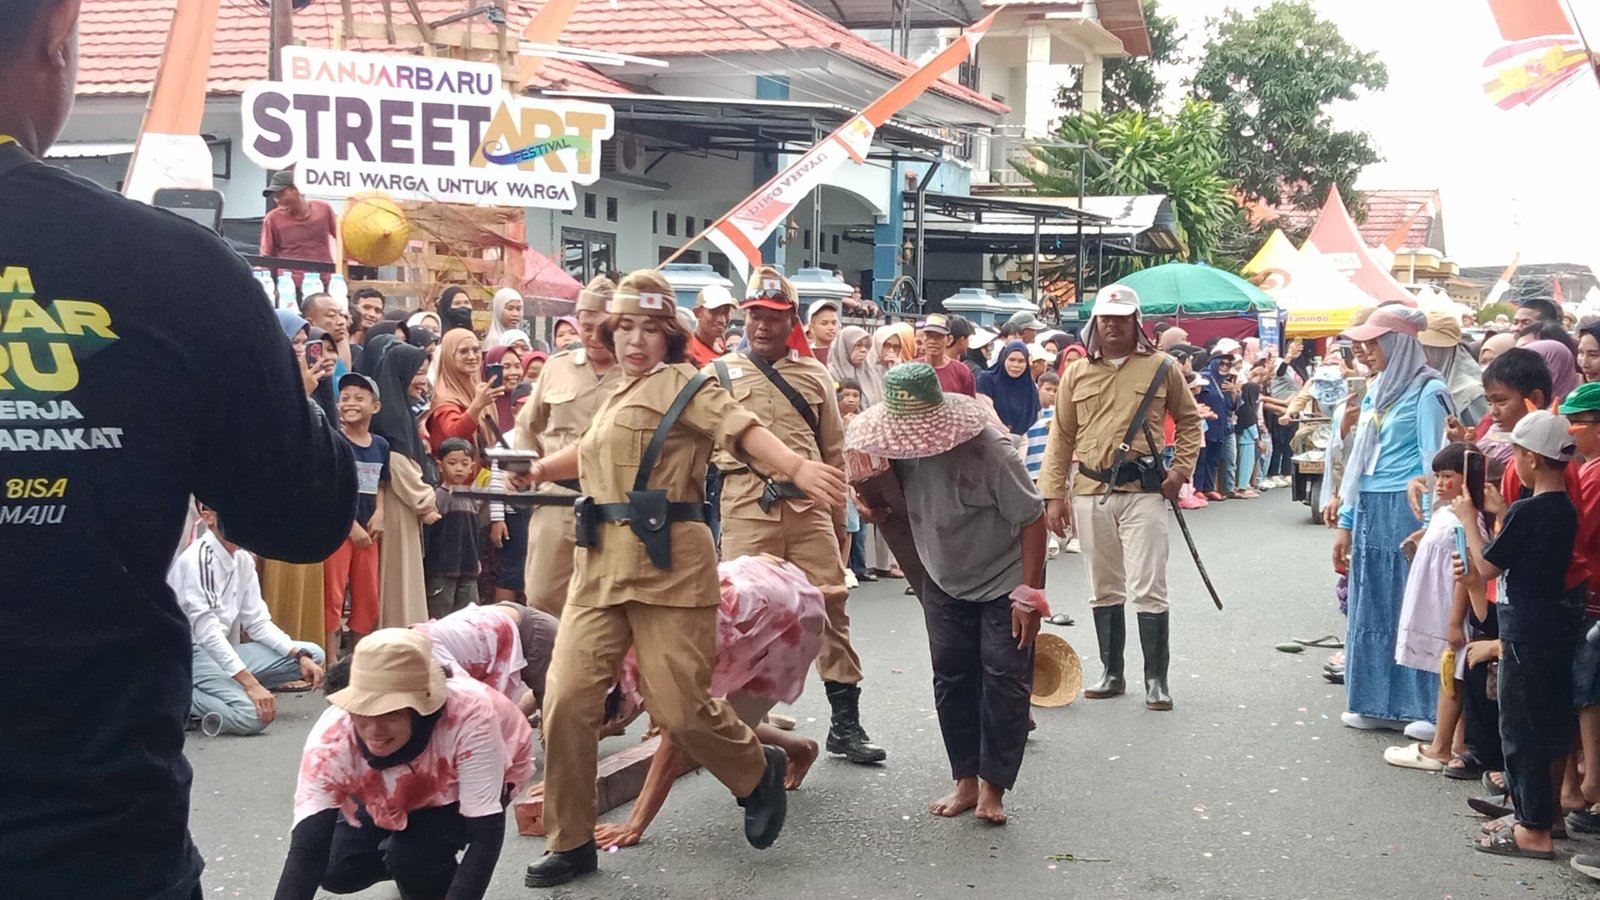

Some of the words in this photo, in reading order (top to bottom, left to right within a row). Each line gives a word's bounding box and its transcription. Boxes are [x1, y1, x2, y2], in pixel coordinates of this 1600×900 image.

[291, 57, 494, 96] BANJARBARU
[252, 91, 492, 167] STREET
[469, 100, 607, 175] ART
[512, 138, 571, 162] FESTIVAL
[306, 168, 351, 188] DARI
[360, 172, 429, 194] WARGA
[438, 177, 498, 197] UNTUK
[507, 181, 570, 201] WARGA
[0, 299, 121, 340] AR
[6, 478, 69, 499] BISA
[0, 505, 67, 525] MAJU
